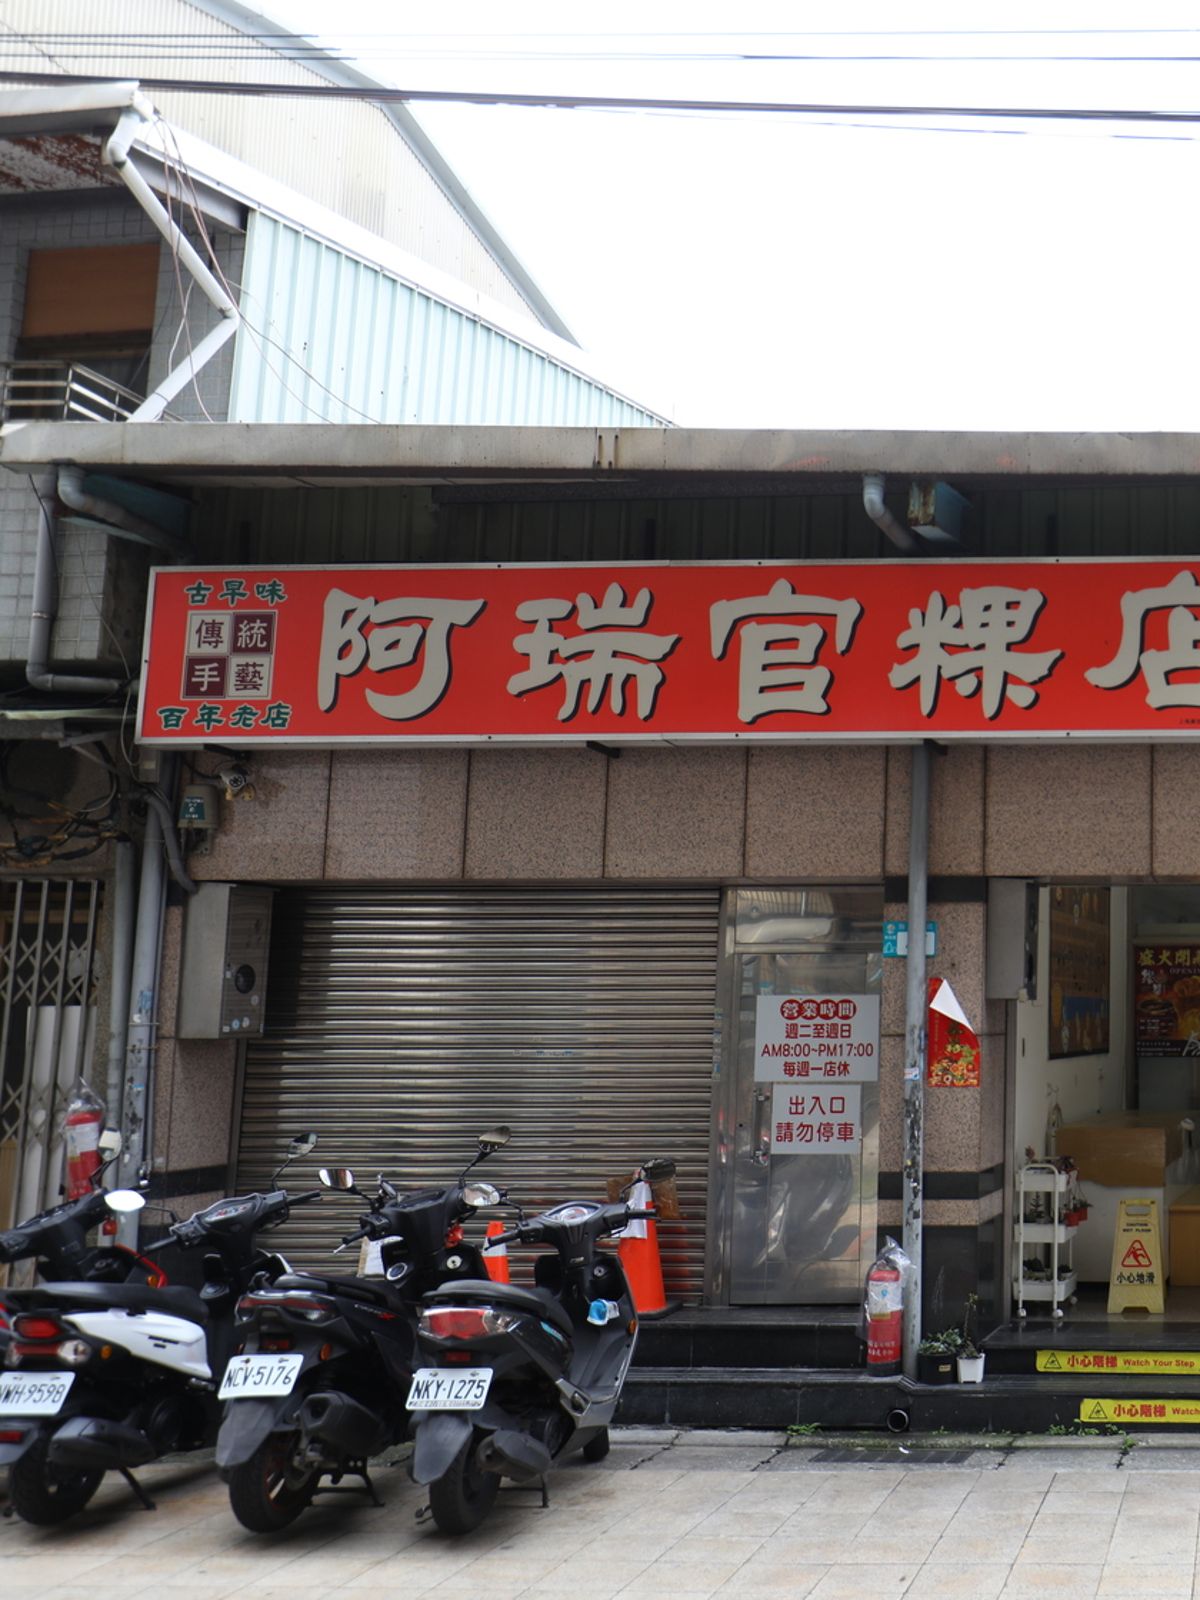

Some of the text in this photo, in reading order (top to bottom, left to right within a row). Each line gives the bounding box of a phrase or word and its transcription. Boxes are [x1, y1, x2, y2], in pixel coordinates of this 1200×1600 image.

[184, 579, 288, 605] 古早味
[194, 619, 269, 650] 傳統
[189, 661, 265, 693] 手藝
[157, 701, 292, 731] 百年老店
[782, 1001, 855, 1018] 營業時間
[785, 1023, 852, 1039] 週二至週日
[761, 1043, 874, 1057] AM8:00~PM17:00
[783, 1061, 850, 1077] 每週一店休
[789, 1096, 845, 1115] 出入口
[775, 1122, 855, 1143] 請勿停車
[1117, 1271, 1155, 1284] 小心地滑
[1067, 1355, 1195, 1368] 小心階梯 Watch Your Step
[1113, 1404, 1166, 1418] 小心階梯
[1172, 1407, 1200, 1416] Watch
